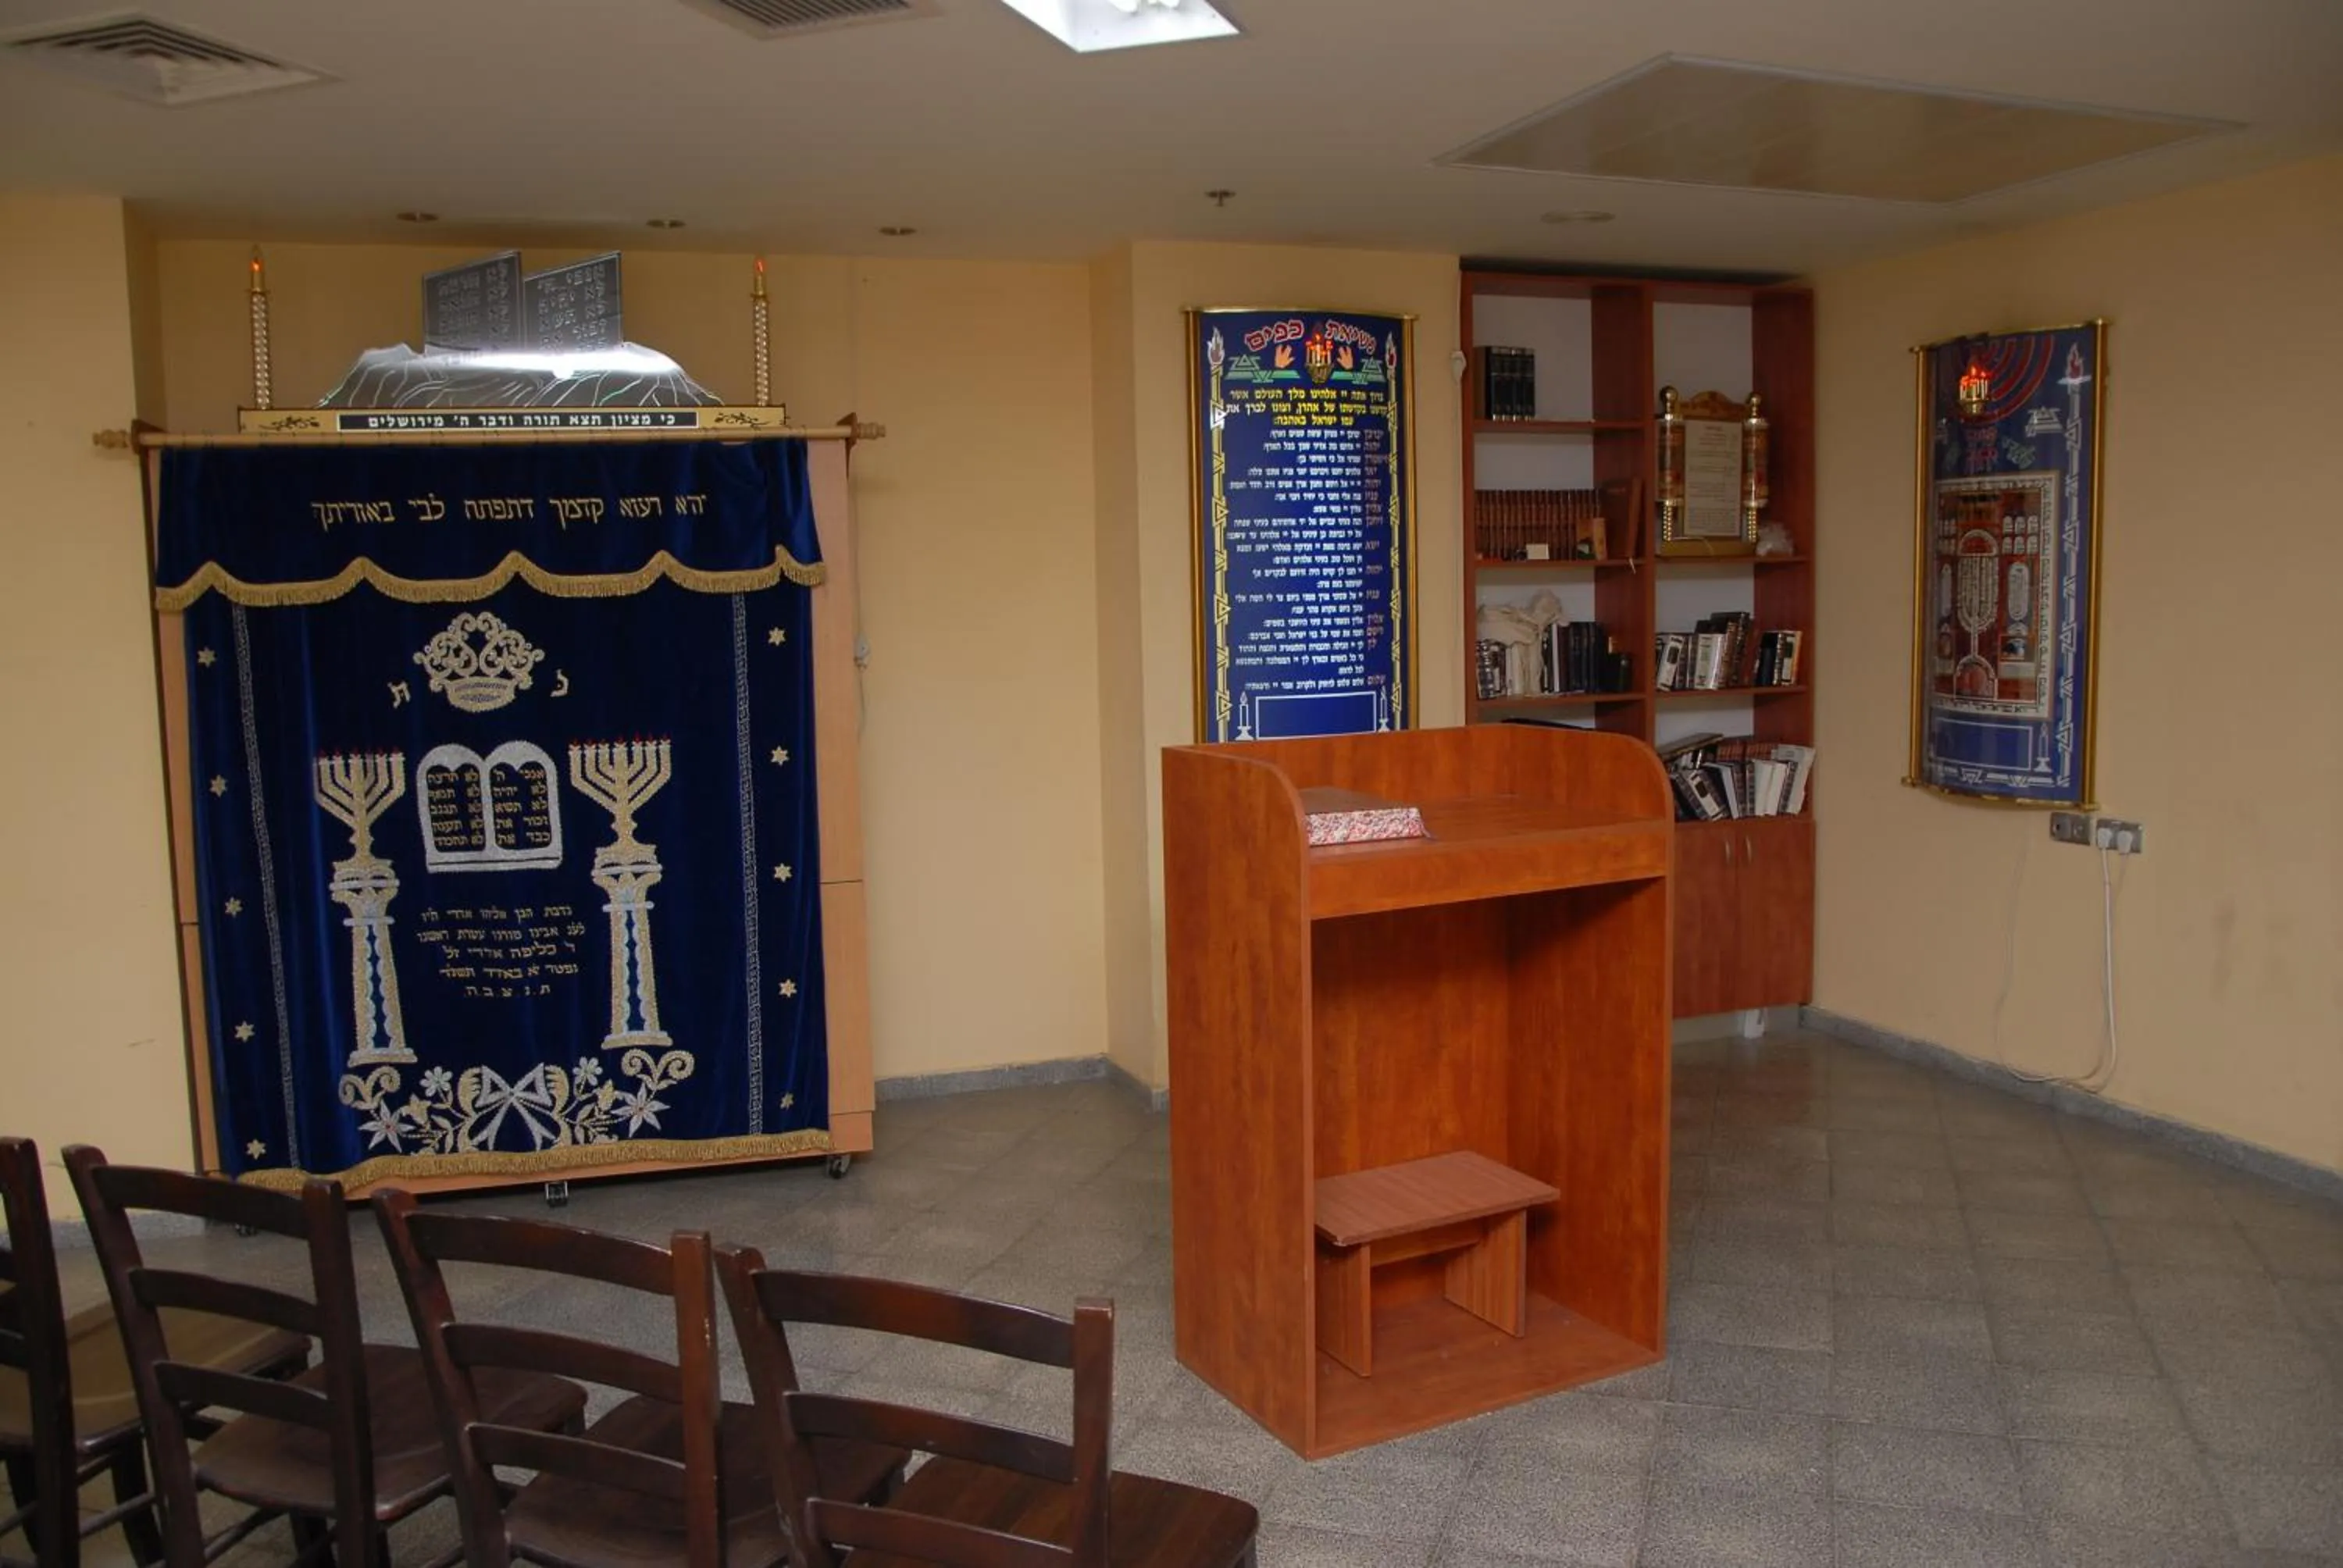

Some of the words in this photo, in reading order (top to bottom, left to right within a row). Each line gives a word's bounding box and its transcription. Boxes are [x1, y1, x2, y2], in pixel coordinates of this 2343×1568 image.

[1244, 319, 1305, 351] כפים
[368, 415, 444, 429] מירושלים
[454, 415, 469, 429] ה'
[480, 415, 514, 429] ודבר
[524, 415, 561, 428] תורה
[570, 414, 601, 427] תצא
[611, 414, 651, 430] מציון
[660, 414, 677, 426] כי
[408, 493, 445, 522] לבי
[463, 498, 534, 519] דתפתח
[619, 497, 662, 518] רעוא
[676, 494, 706, 515] יהא
[549, 498, 604, 531] קדמך
[492, 786, 519, 796] יהיה
[526, 832, 551, 843] כבד
